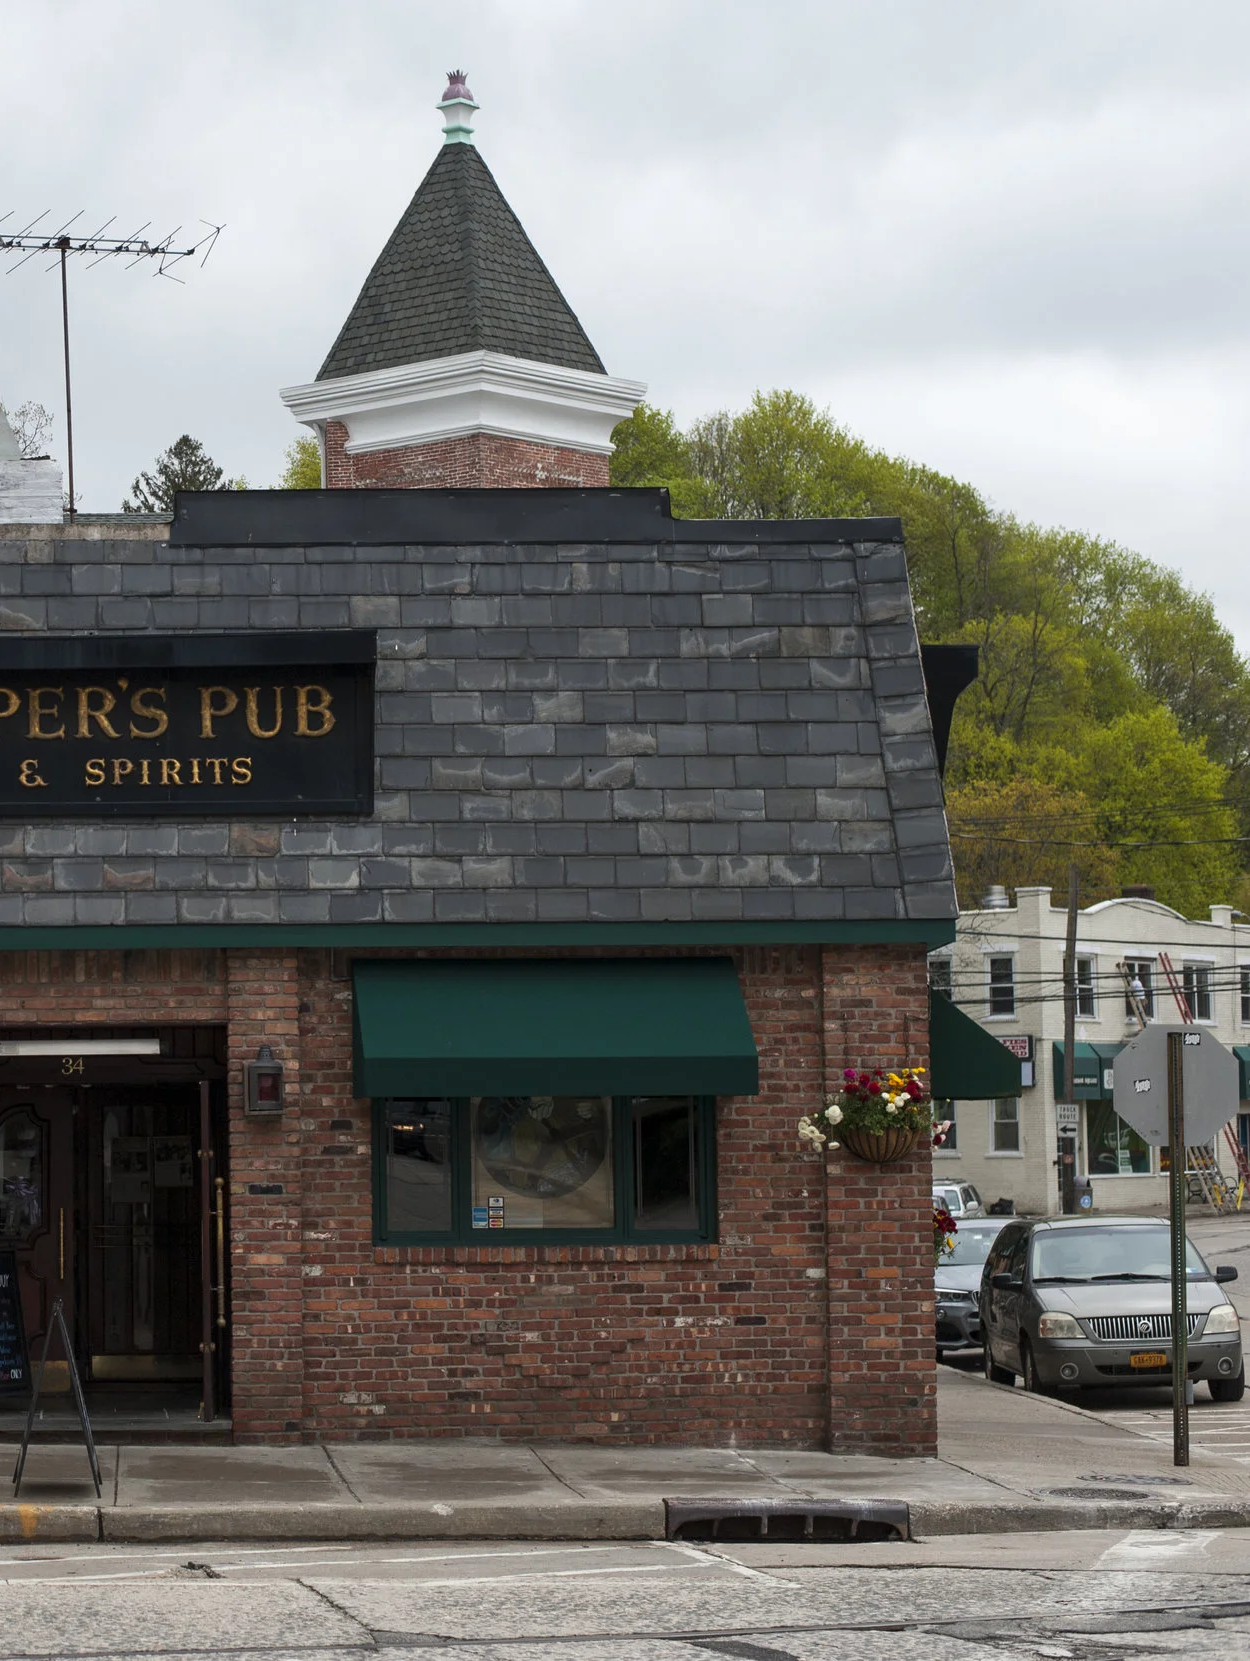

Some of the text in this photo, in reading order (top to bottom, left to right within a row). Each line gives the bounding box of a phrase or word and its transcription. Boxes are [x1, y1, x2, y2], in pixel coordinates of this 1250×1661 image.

[197, 683, 337, 740] PUB
[18, 759, 49, 788] &
[84, 757, 253, 787] SPIRITS
[61, 1057, 85, 1075] 34
[10, 1368, 23, 1379] ONLY
